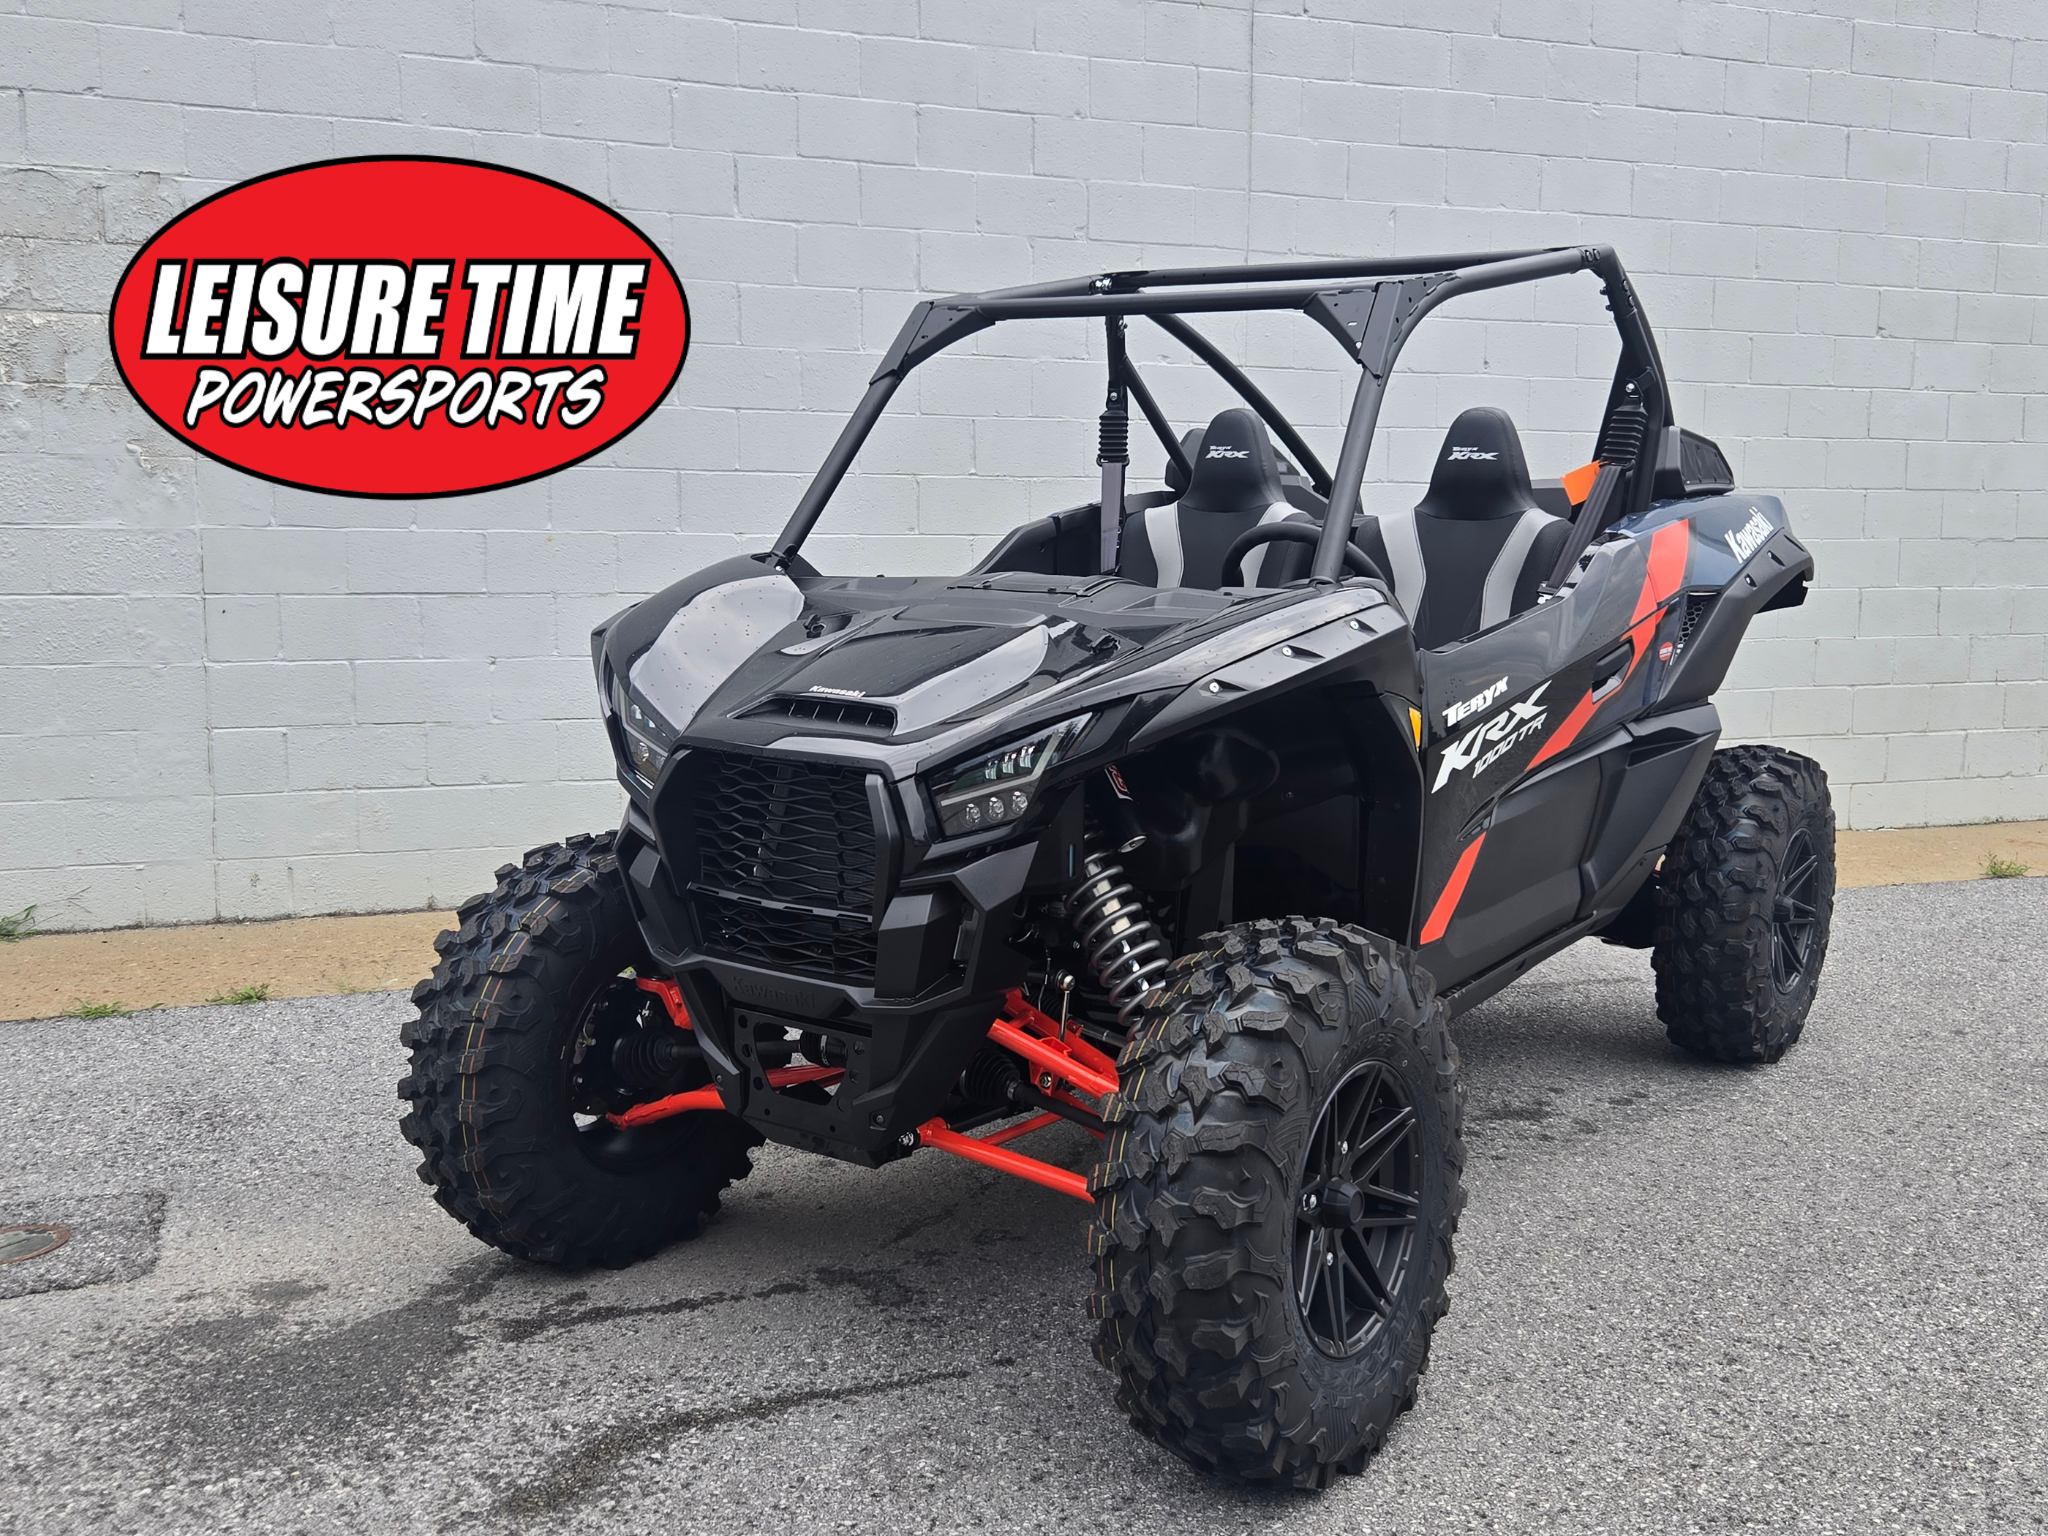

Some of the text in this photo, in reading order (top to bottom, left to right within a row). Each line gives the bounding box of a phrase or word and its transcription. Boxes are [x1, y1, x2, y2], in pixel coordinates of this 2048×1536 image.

[1205, 450, 1250, 459] KRX
[1447, 451, 1499, 461] KRX
[1723, 506, 1774, 564] Kawasaki
[808, 685, 867, 698] Kawasaki
[1430, 680, 1553, 794] KRX
[732, 975, 816, 1010] Kawasaki
